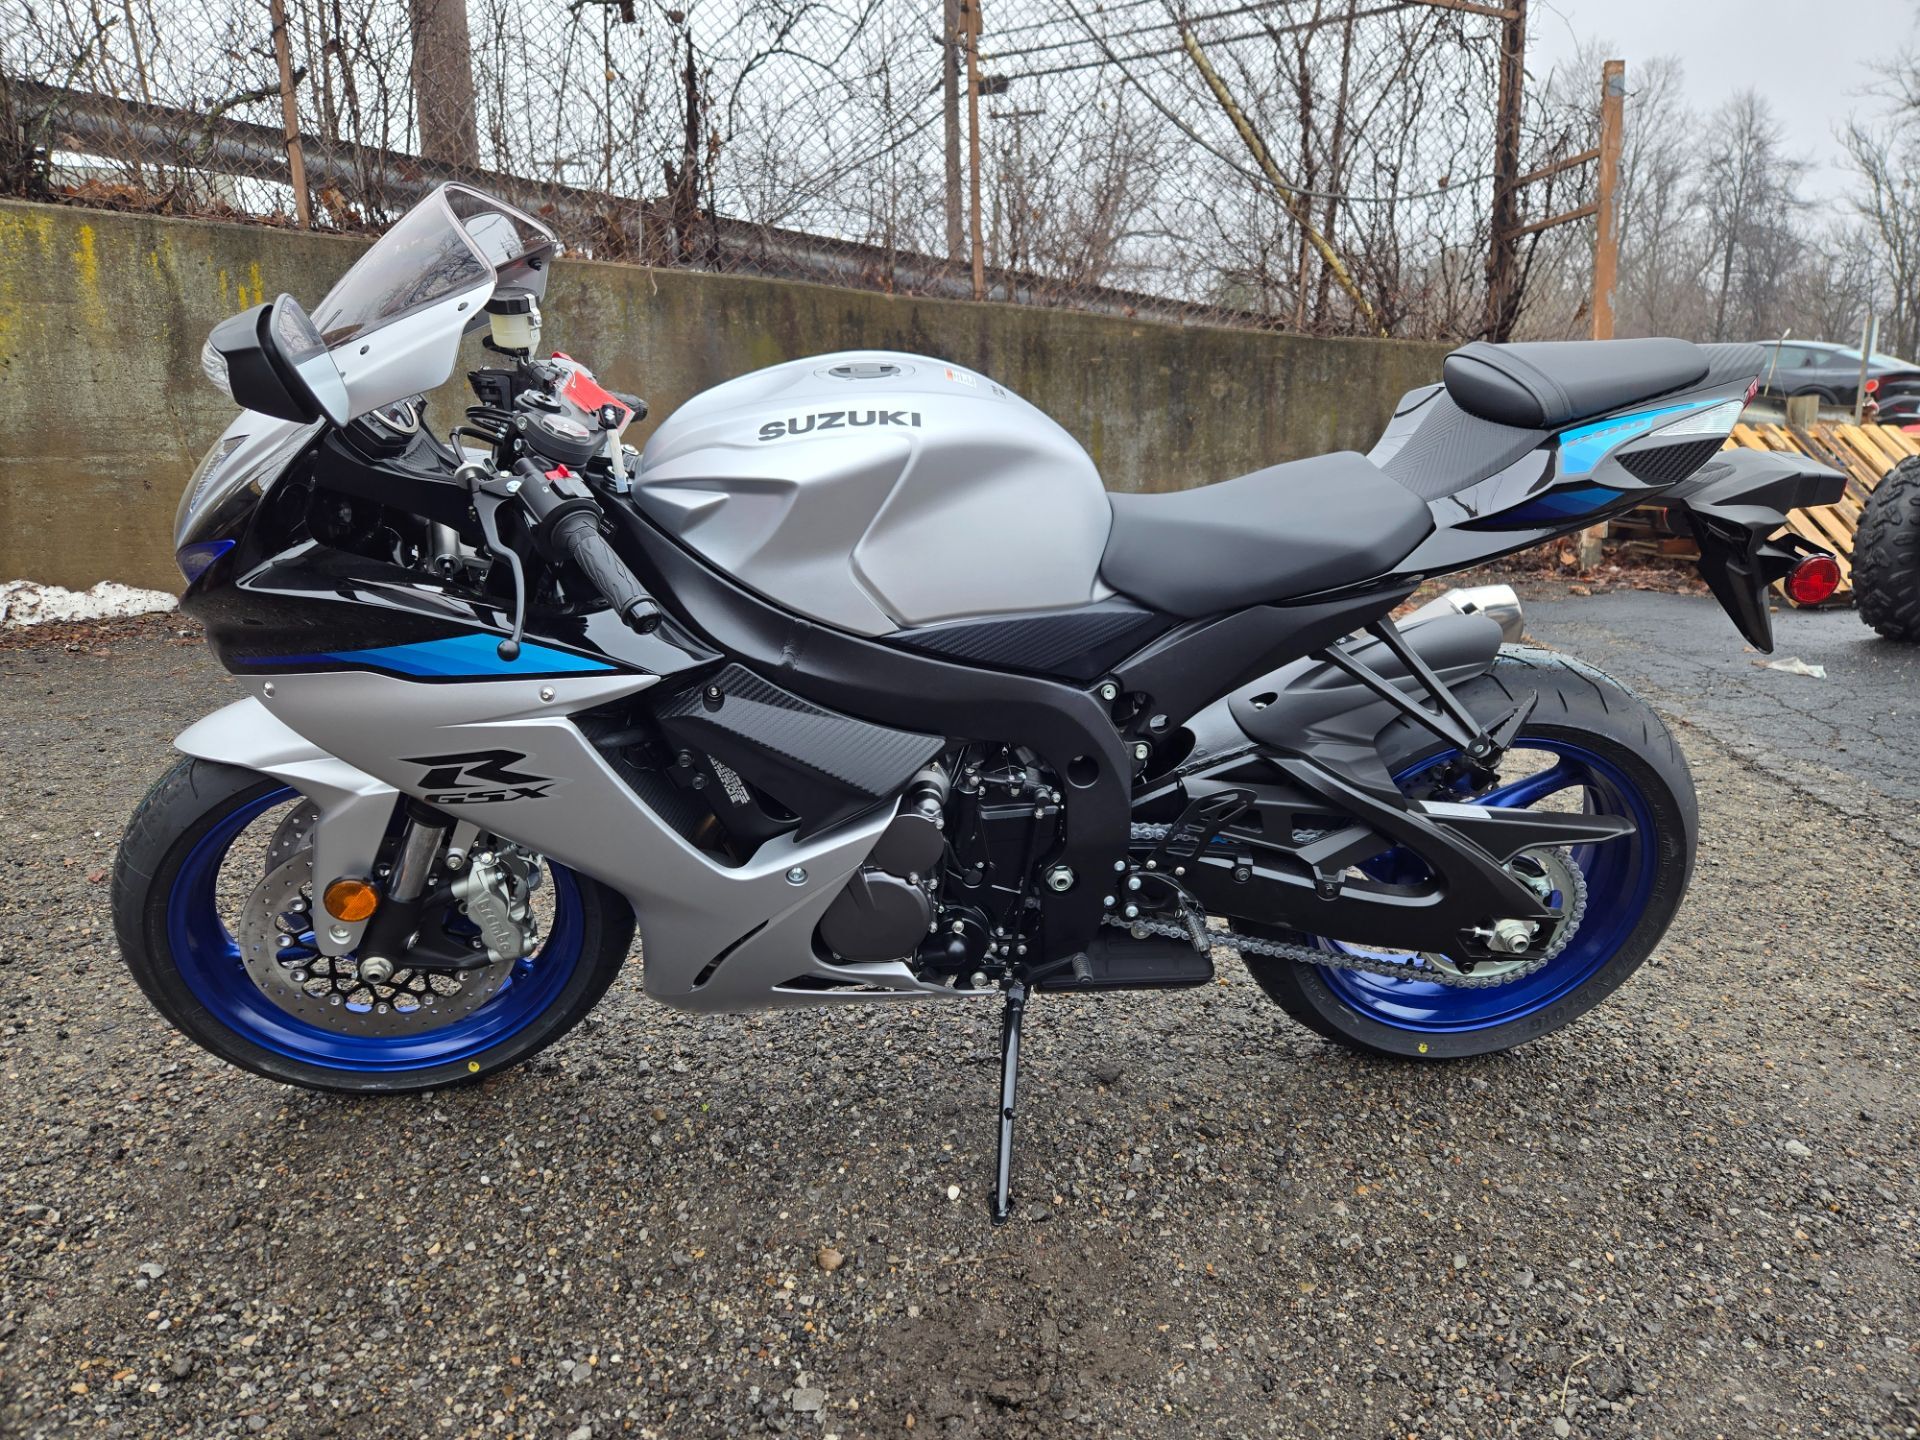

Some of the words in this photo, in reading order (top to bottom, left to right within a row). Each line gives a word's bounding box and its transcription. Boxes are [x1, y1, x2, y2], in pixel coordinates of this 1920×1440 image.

[758, 410, 922, 441] SUZUKI
[398, 749, 554, 790] R
[424, 783, 556, 805] GSX
[478, 898, 511, 953] brembo
